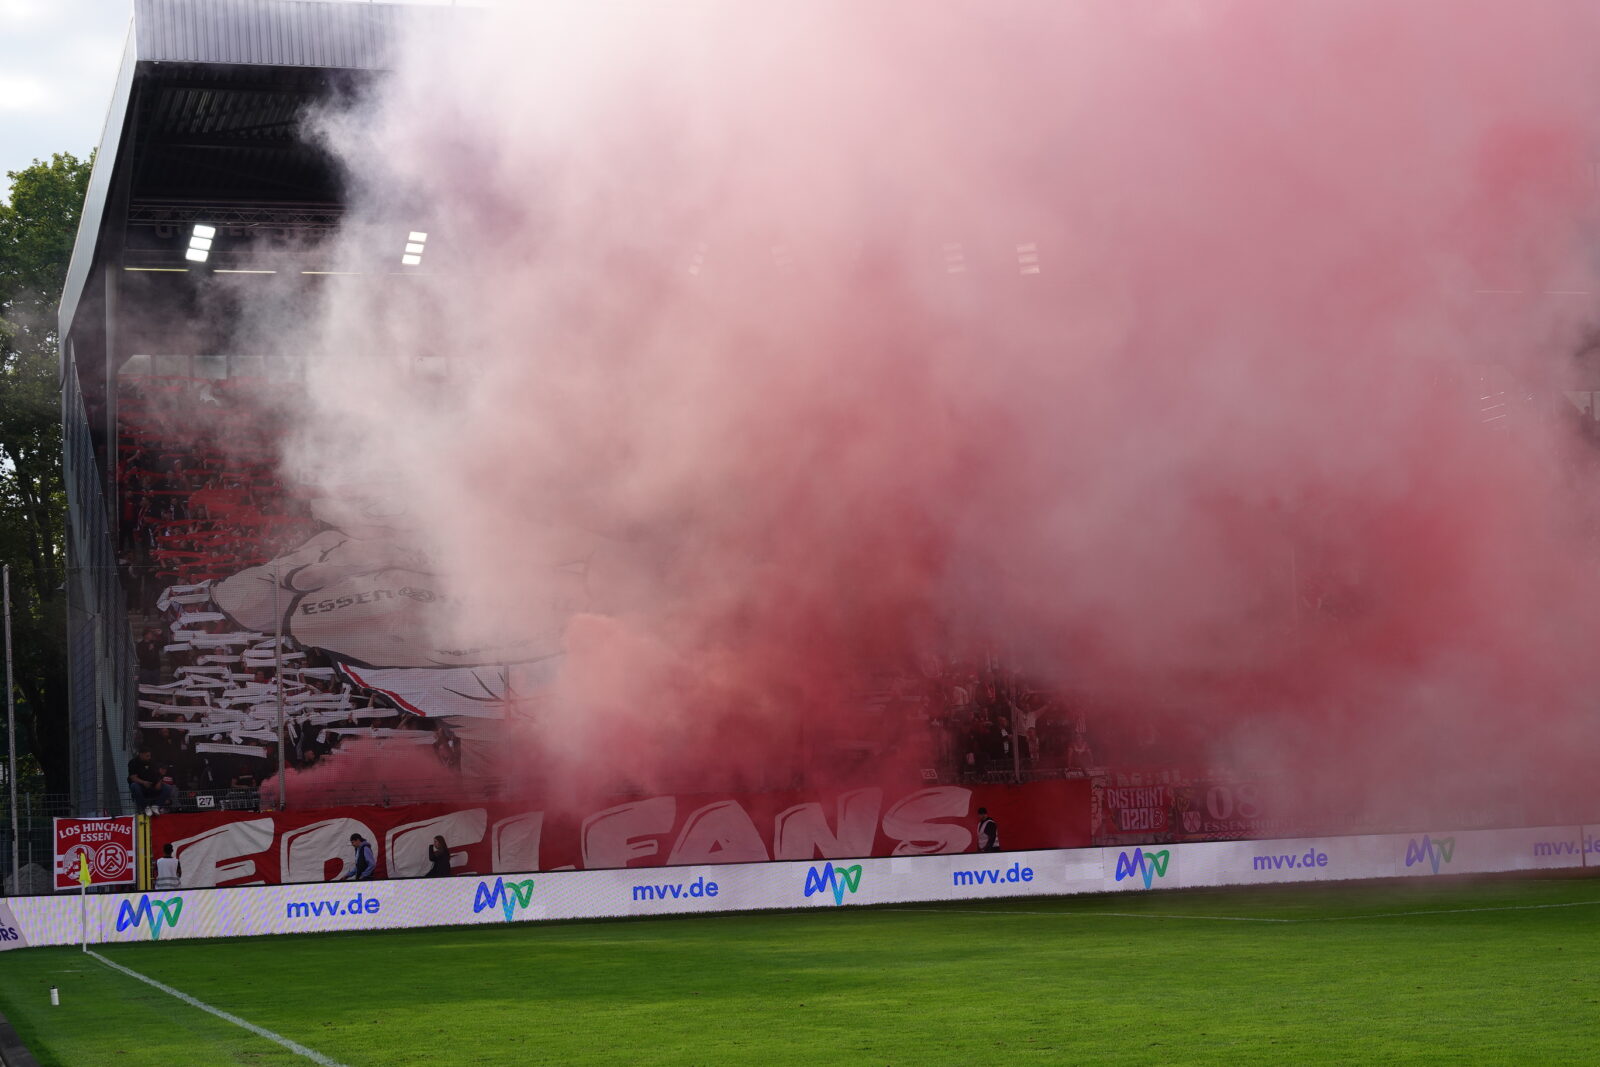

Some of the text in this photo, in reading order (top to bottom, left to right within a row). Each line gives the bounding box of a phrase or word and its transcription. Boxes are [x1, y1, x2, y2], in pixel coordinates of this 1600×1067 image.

[300, 588, 393, 615] ESSEN
[199, 797, 212, 806] 27
[58, 822, 131, 839] LOS HINCHAS
[80, 832, 112, 842] ESSEN
[1253, 849, 1328, 871] mvv.de
[952, 862, 1034, 886] mvv.de
[632, 876, 719, 901] mvv.de
[286, 893, 381, 919] mvv.de
